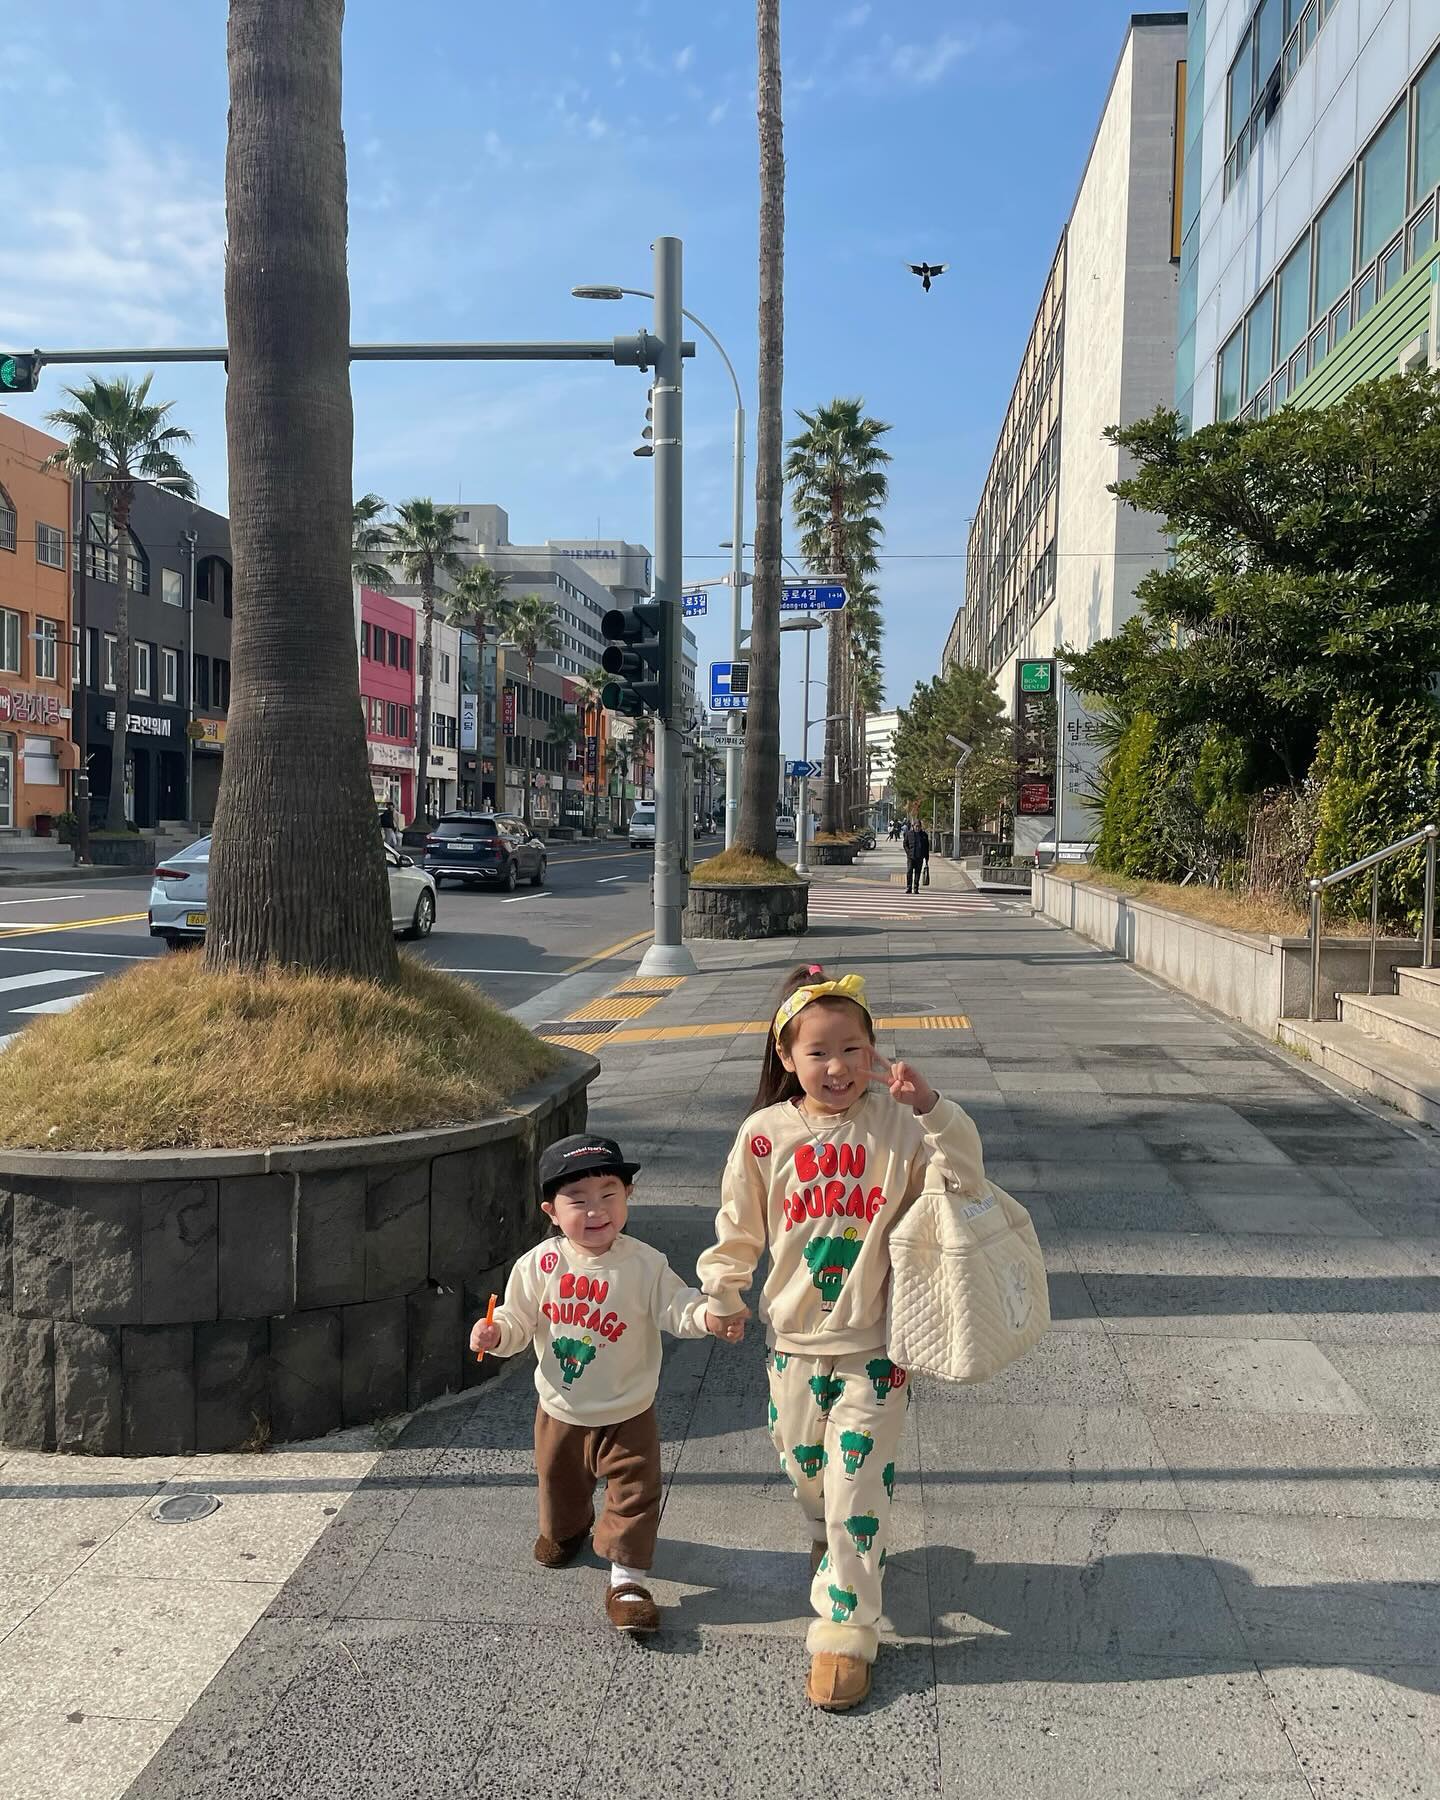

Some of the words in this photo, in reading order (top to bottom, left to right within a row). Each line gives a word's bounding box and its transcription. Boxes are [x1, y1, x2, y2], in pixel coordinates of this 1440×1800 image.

[13, 691, 61, 725] 감자탕
[106, 711, 171, 737] 코인워시
[794, 1143, 866, 1182] BON
[559, 1272, 610, 1304] BON
